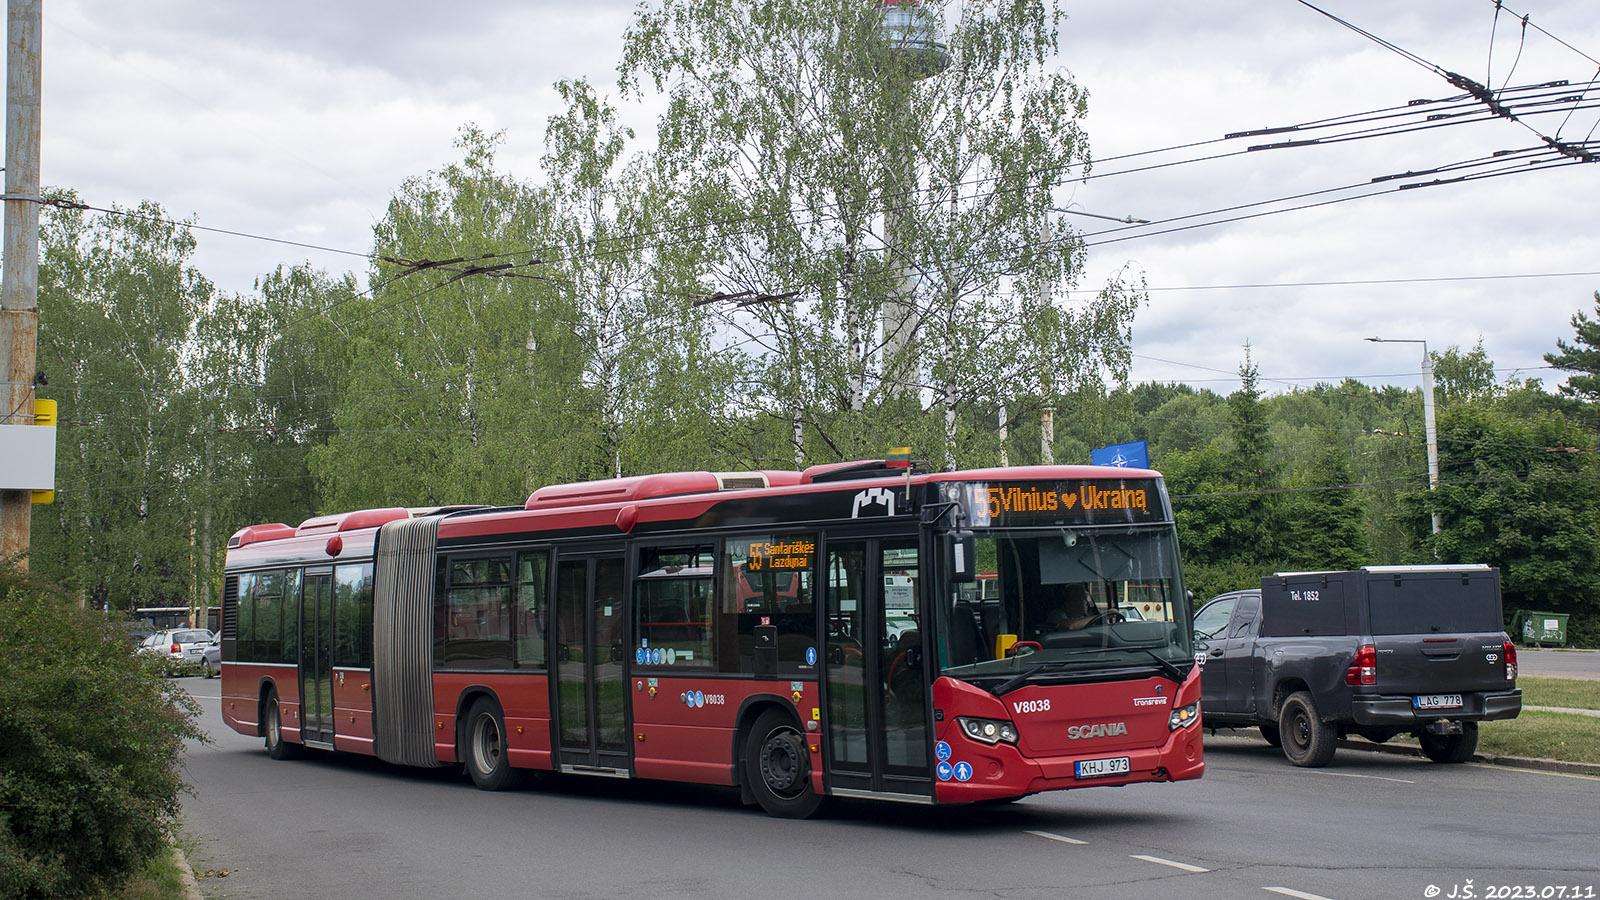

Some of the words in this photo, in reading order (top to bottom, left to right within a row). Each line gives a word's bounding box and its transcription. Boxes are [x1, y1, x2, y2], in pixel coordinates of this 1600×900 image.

[974, 488, 1000, 518] 55
[1000, 487, 1058, 512] Vilnius
[1080, 485, 1147, 513] Ukrainą
[749, 543, 763, 570] 55
[769, 554, 807, 568] Lazdynai
[1290, 590, 1302, 601] Tel.
[1303, 590, 1320, 601] 1852
[704, 694, 725, 705] V8038
[1013, 699, 1051, 714] V8038
[1418, 696, 1439, 706] LAG
[1444, 695, 1462, 705] 778
[1067, 722, 1128, 740] SCANIA
[1081, 761, 1104, 775] KHJ
[1109, 758, 1128, 772] 973
